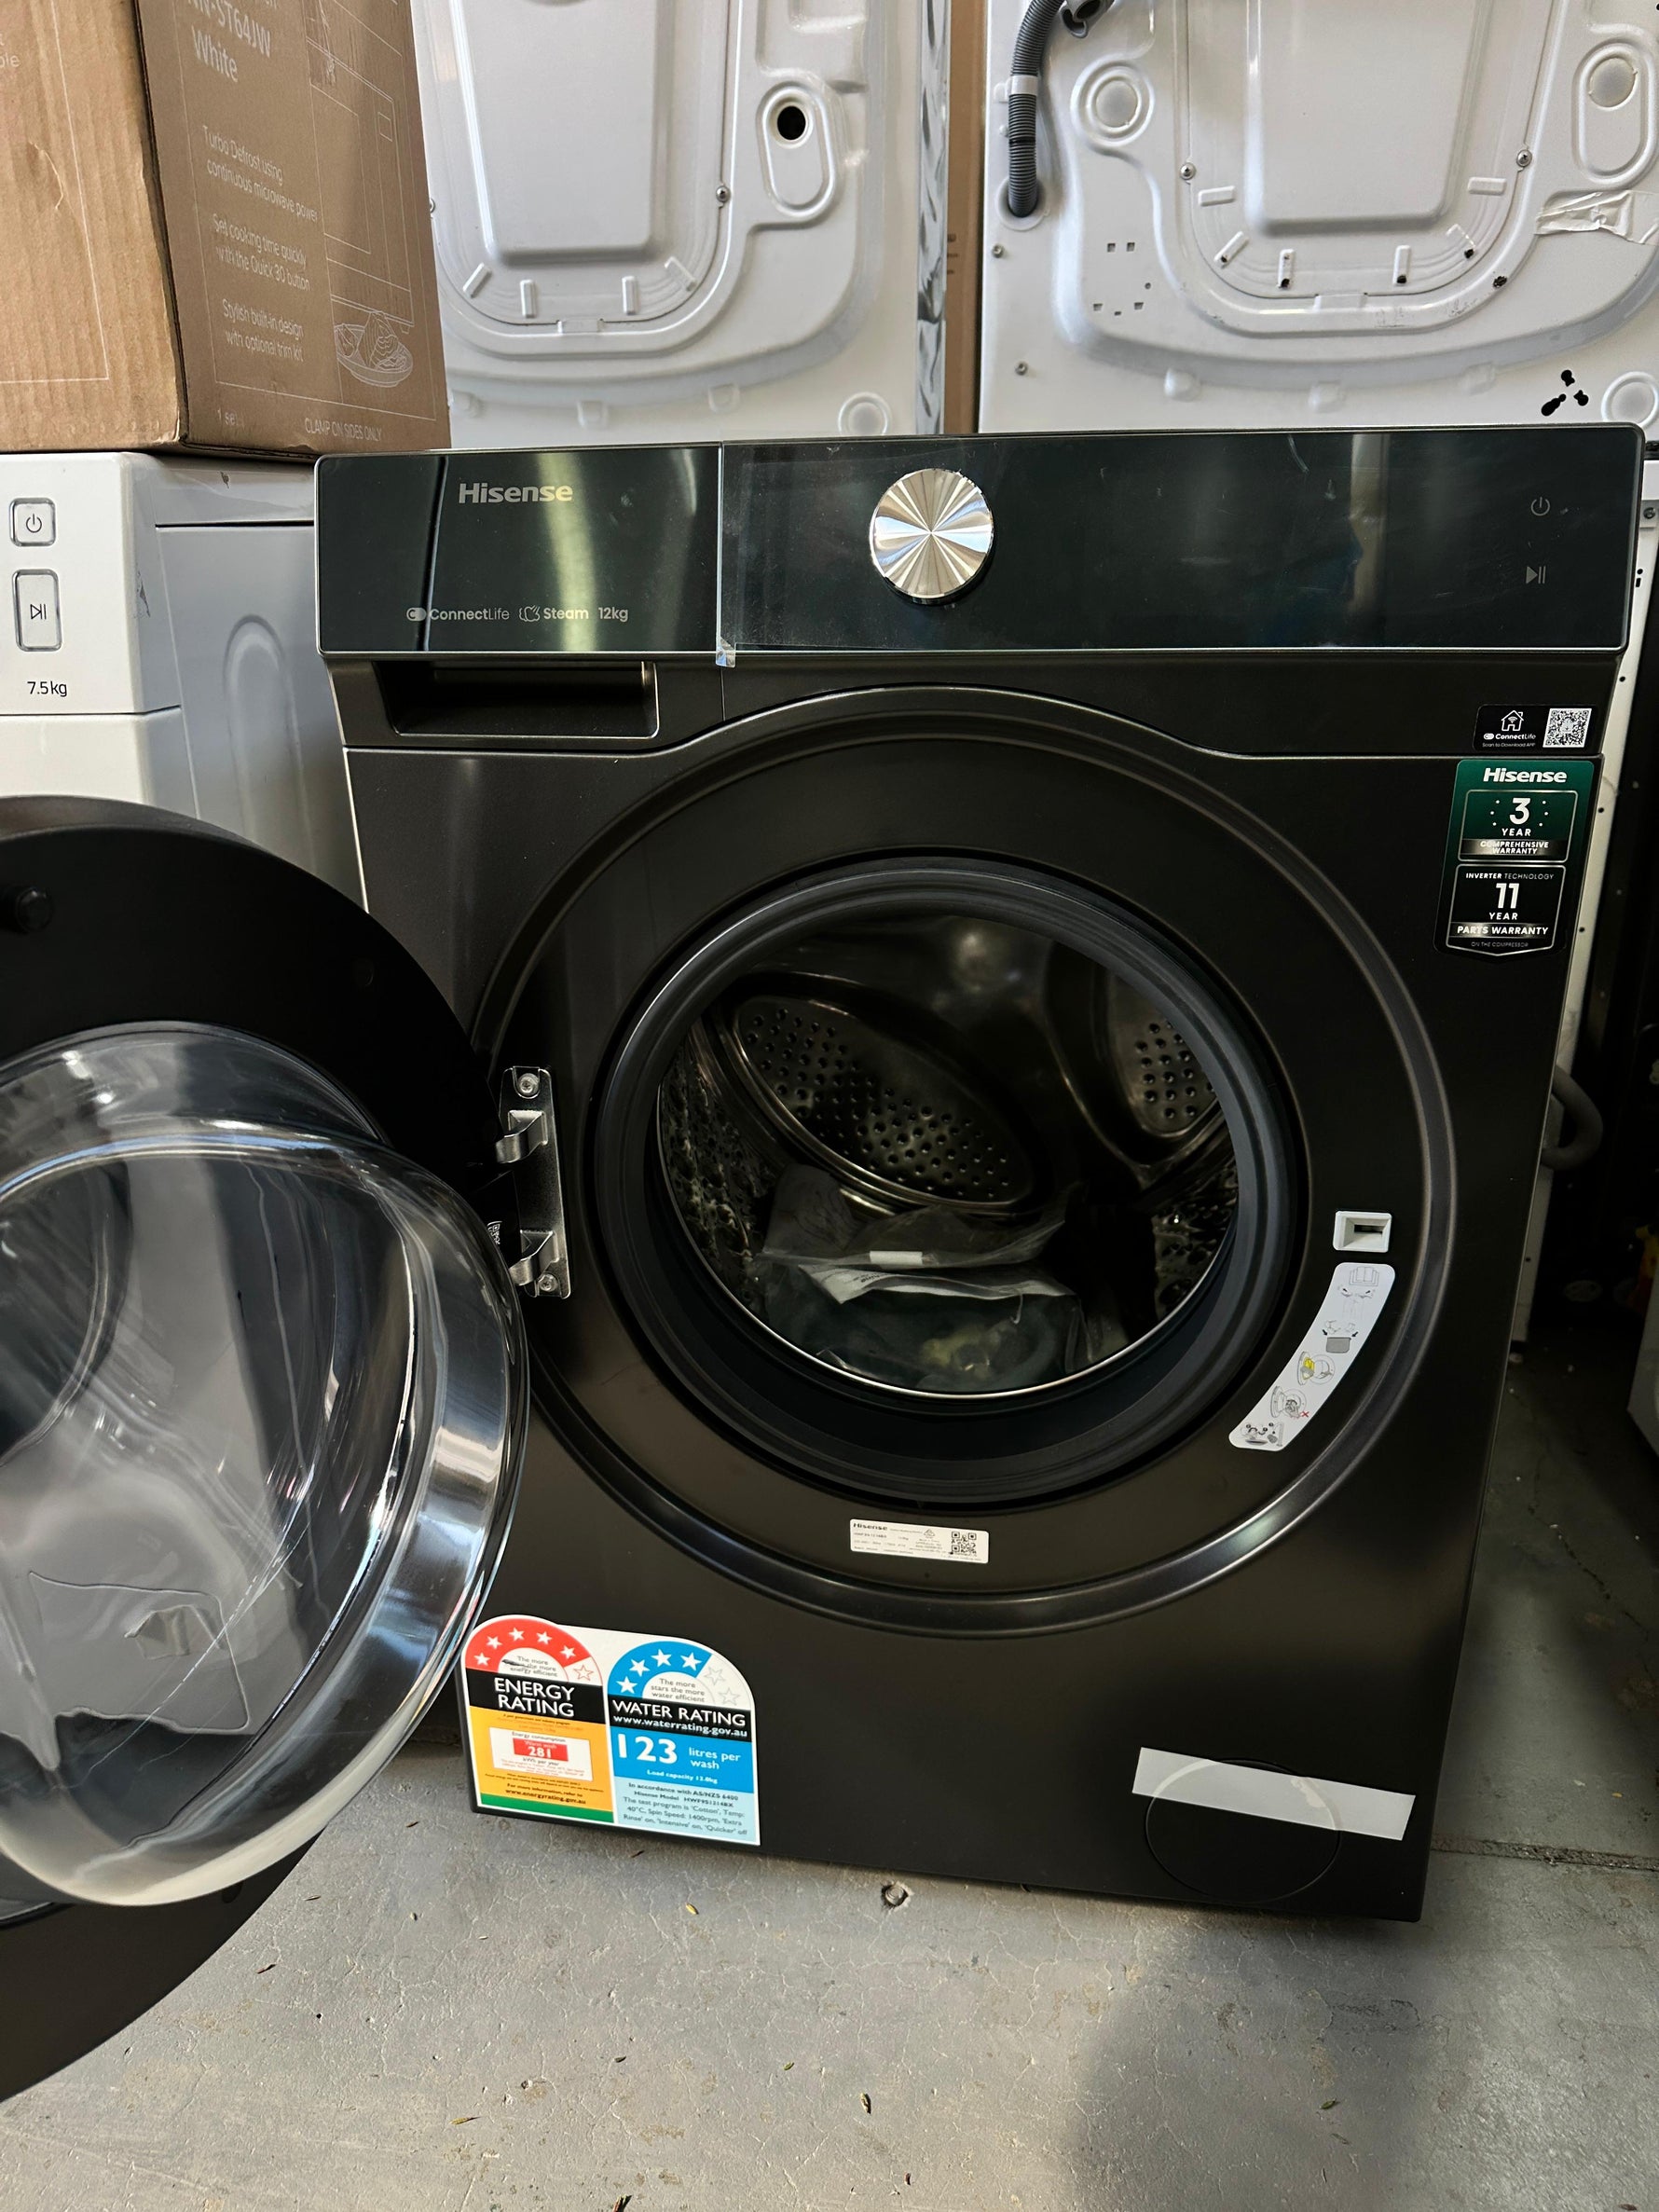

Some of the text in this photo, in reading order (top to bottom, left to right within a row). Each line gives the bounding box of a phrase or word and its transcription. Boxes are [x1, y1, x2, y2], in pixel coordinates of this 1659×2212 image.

[191, 24, 238, 83] White
[202, 124, 283, 186] Turbo Defrost using
[207, 158, 318, 223] continuous microwave power
[213, 213, 306, 271] Set cooking time quickly
[215, 245, 310, 292] with the Quick 30 button
[223, 298, 304, 341] Stylish built-in design
[225, 328, 244, 347] with
[245, 335, 277, 355] optional
[277, 341, 293, 359] trim
[305, 417, 381, 442] CLAMP ON SIDES ONLY
[459, 483, 573, 503] Hisense
[430, 607, 629, 623] ConnectLife Steam 12kg
[27, 680, 68, 697] 7.5kg
[1483, 767, 1567, 783] Hisense
[1509, 798, 1531, 825] 3
[1501, 828, 1531, 837] YEAR
[1480, 840, 1549, 848] COMPREHENSIVE
[1496, 883, 1520, 909] 11
[1457, 926, 1548, 935] PARTS WARRANTY
[494, 1678, 575, 1701] ENERGY
[651, 1684, 669, 1693] stars
[659, 1678, 674, 1686] The
[499, 1694, 575, 1718] RATING
[675, 1695, 706, 1703] efficient
[612, 1699, 746, 1726] WATER RATING
[613, 1715, 747, 1738] www.waterrating.gov.au
[528, 1746, 552, 1759] 281
[618, 1733, 678, 1765] 123
[689, 1747, 741, 1763] litres per
[691, 1759, 720, 1770] wash
[647, 1769, 665, 1778] Load
[665, 1772, 693, 1781] capacity
[638, 1784, 675, 1793] accordance
[692, 1791, 720, 1799] AS/NZS
[649, 1808, 663, 1818] Spin
[653, 1801, 682, 1810] program
